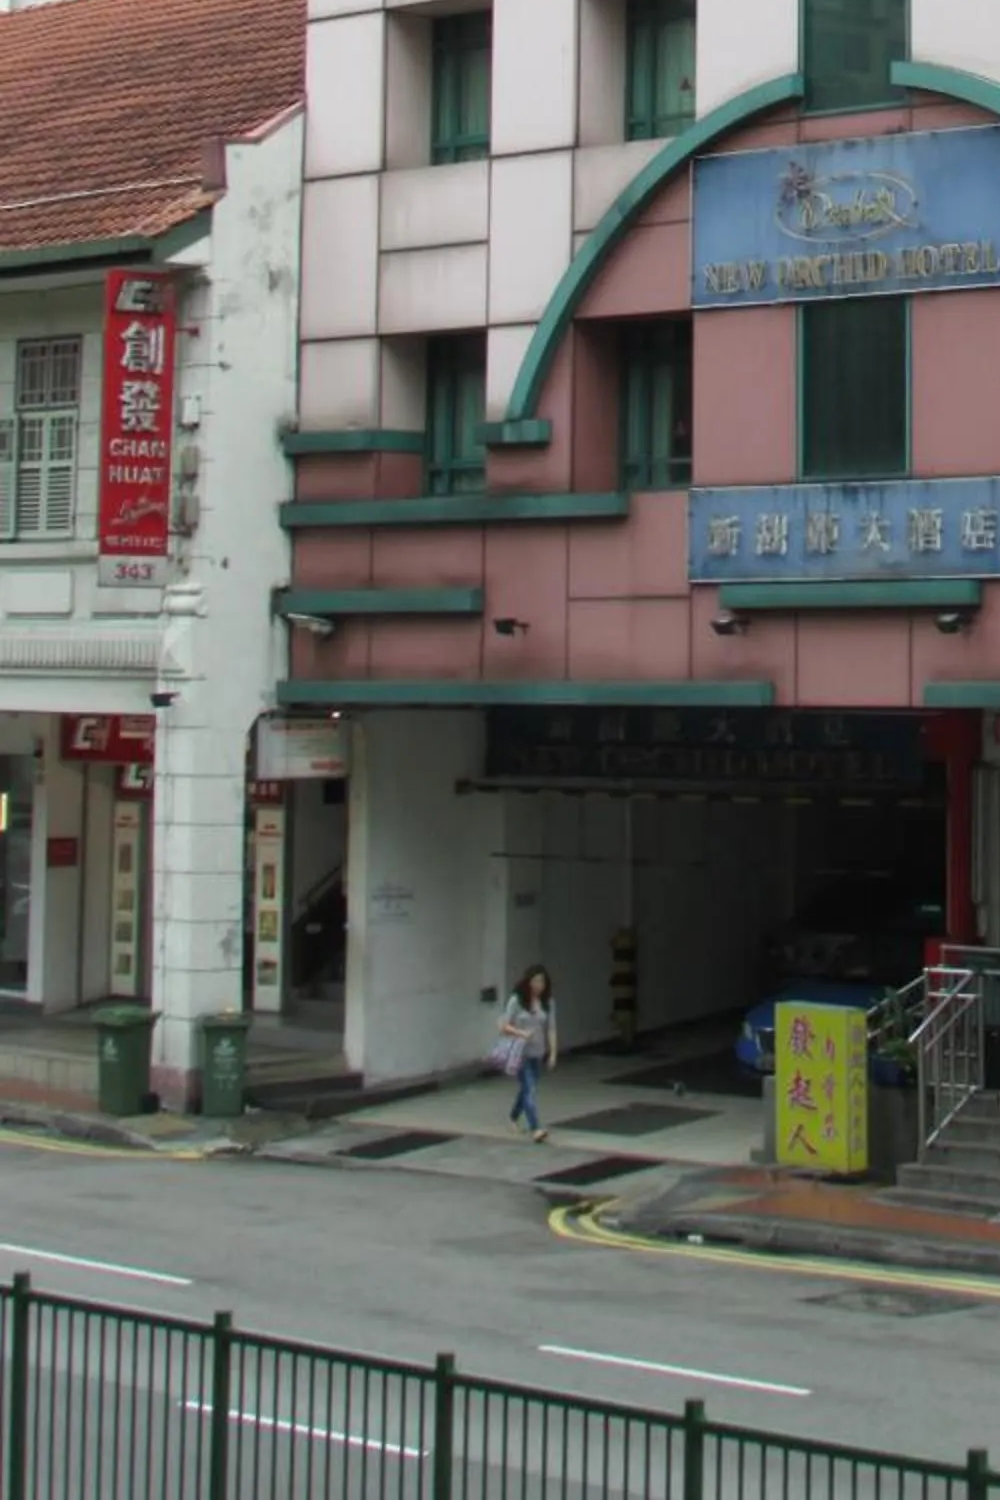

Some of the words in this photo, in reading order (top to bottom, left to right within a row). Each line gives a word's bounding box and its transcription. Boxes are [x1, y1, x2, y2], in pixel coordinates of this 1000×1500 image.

[702, 261, 768, 295] NEW
[108, 437, 166, 459] CHAN
[108, 465, 165, 485] HUAT
